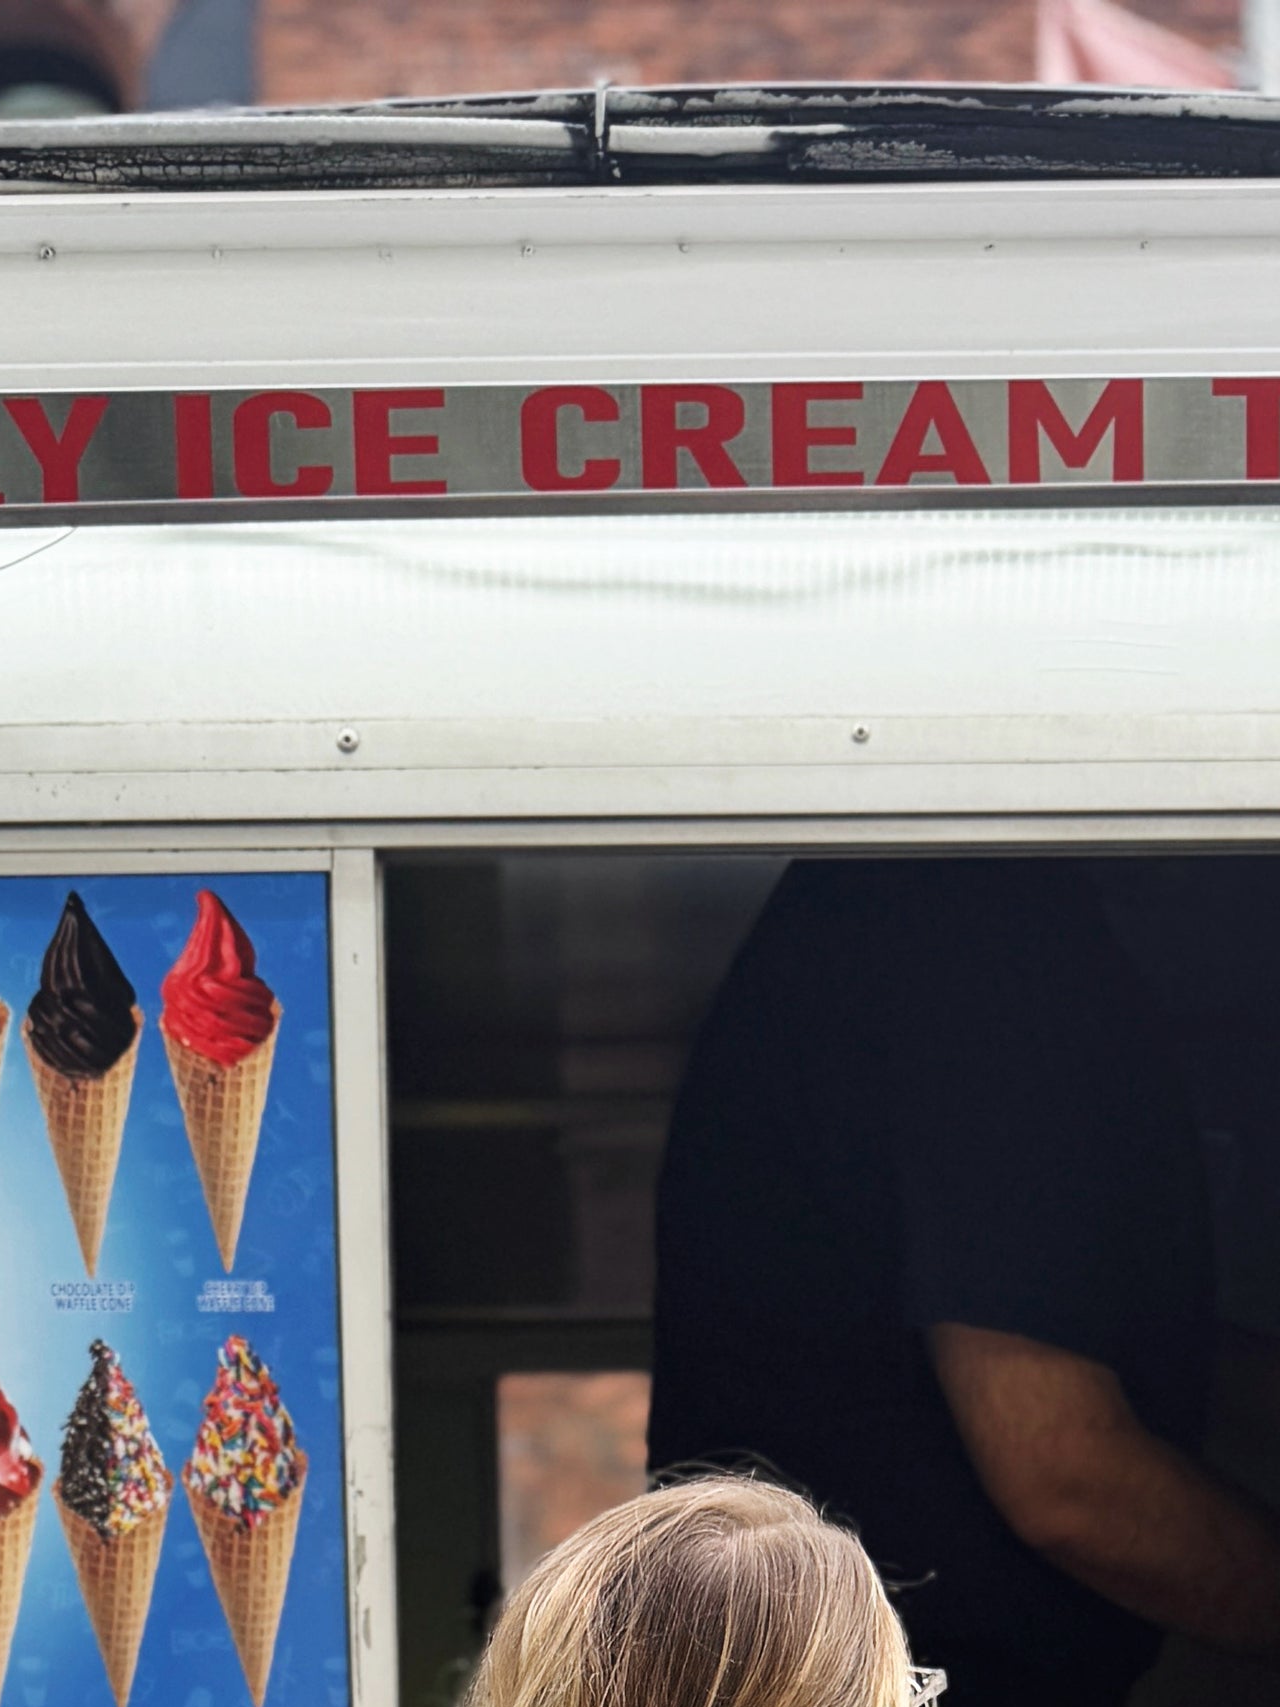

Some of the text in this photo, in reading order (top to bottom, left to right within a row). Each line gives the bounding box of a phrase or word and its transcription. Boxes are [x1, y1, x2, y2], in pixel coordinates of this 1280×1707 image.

[171, 388, 448, 498] ICE
[519, 378, 1145, 491] CREAM
[51, 1283, 111, 1297] CHOCOLATE
[55, 1298, 133, 1311] WAFFLE CONE
